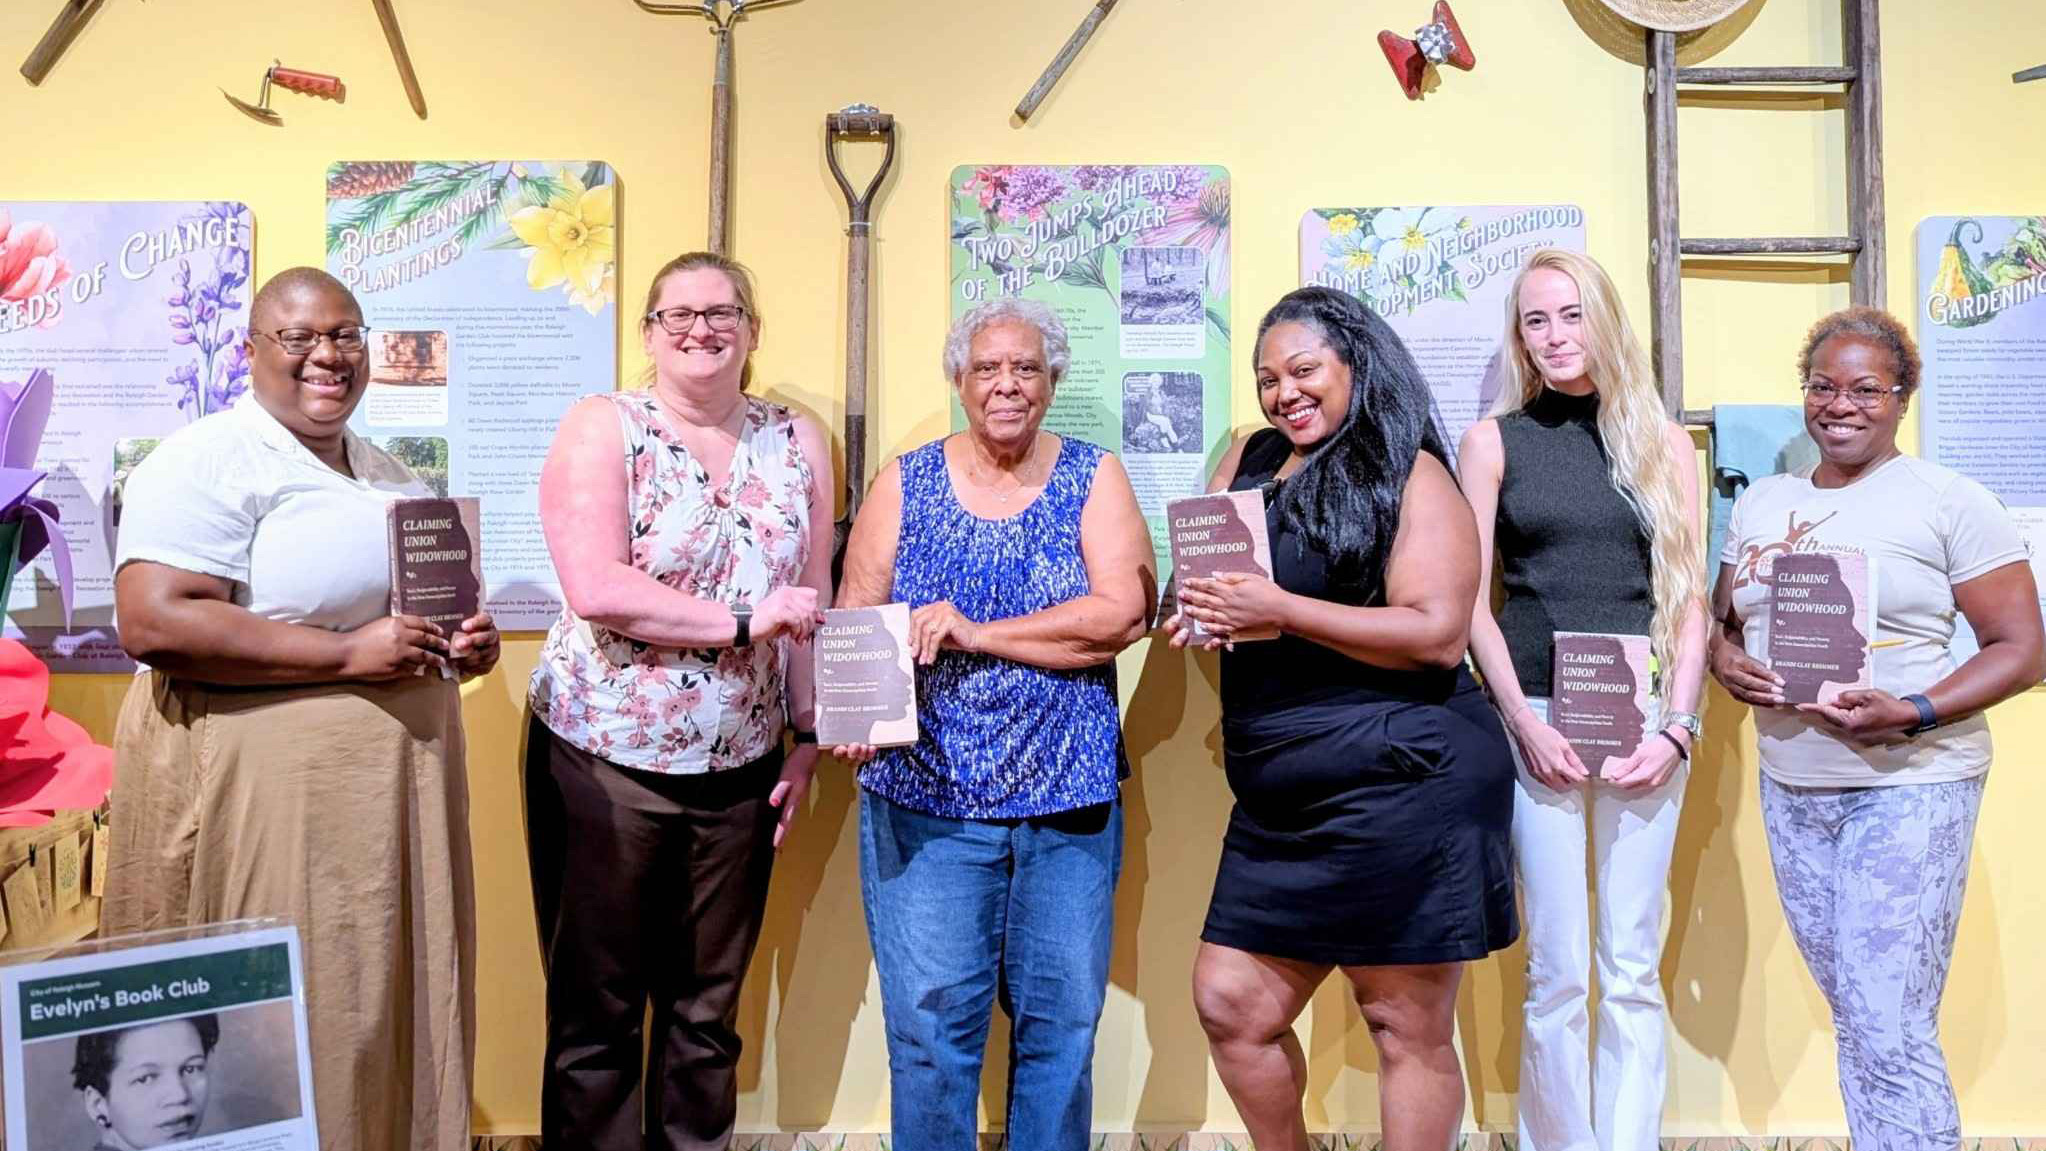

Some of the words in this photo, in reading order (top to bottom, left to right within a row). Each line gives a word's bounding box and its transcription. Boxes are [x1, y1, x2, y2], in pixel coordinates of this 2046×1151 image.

[340, 182, 498, 267] BICENTENNIAL
[961, 234, 1013, 271] TWO
[1018, 194, 1095, 257] JUMPS
[1097, 170, 1179, 221] AHEAD
[961, 277, 988, 301] OF
[997, 264, 1035, 297] THE
[1045, 205, 1168, 281] BULLDOZER
[1304, 269, 1373, 294] HOME
[1380, 253, 1421, 283] AND
[1425, 206, 1584, 276] NEIGHBORHOOD
[71, 261, 108, 303] OF
[119, 217, 240, 281] CHANGE
[340, 233, 464, 293] PLANTINGS
[402, 518, 452, 531] CLAIMING
[1175, 514, 1227, 528] CLAIMING
[404, 535, 437, 547] UNION
[1177, 530, 1211, 543] UNION
[405, 549, 467, 563] WIDOWHOOD
[1178, 542, 1247, 558] WIDOWHOOD
[1777, 573, 1830, 585] CLAIMING
[1777, 588, 1810, 599] UNION
[1776, 602, 1848, 615] WIDOWHOOD
[821, 624, 874, 636] CLAIMING
[822, 638, 857, 649] UNION
[822, 649, 893, 663] WIDOWHOOD
[1562, 652, 1616, 665] CLAIMING
[1562, 666, 1597, 678] UNION
[1562, 680, 1630, 695] WIDOWHOOD
[29, 993, 111, 1021] Evelyn's
[114, 985, 164, 1008] Book
[168, 976, 211, 999] Club
